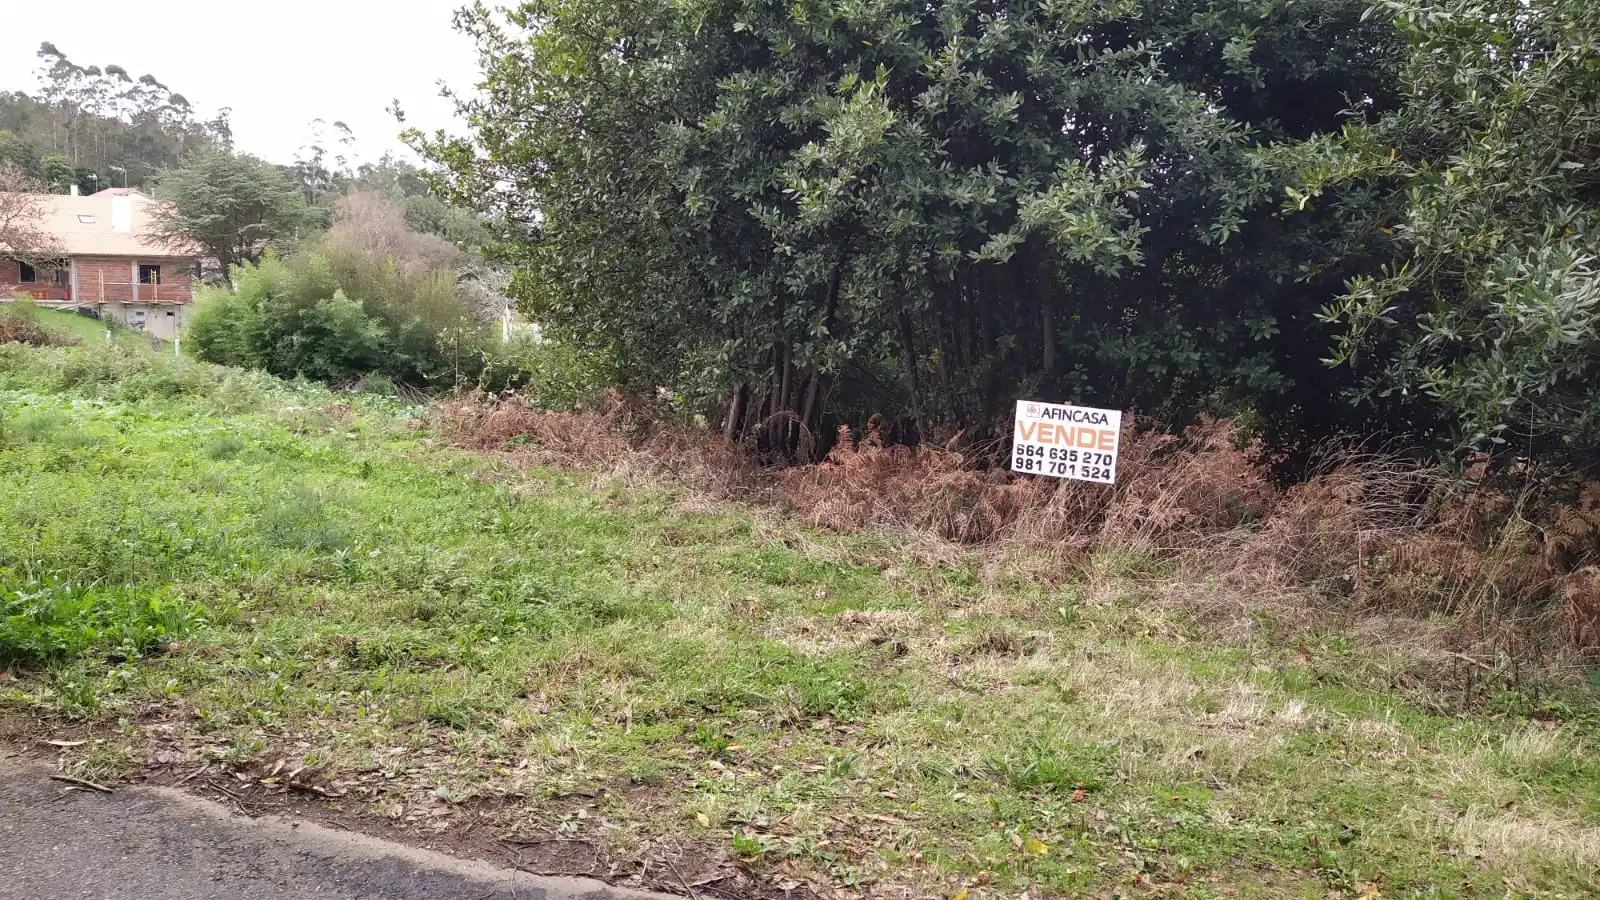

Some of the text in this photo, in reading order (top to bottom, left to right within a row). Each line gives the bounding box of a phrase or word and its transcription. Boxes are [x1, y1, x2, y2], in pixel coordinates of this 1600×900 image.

[1041, 407, 1109, 425] AFINCASA
[1018, 420, 1115, 452] VENDE
[1016, 444, 1112, 466] 664 635 270
[1015, 457, 1110, 480] 981 701 524
